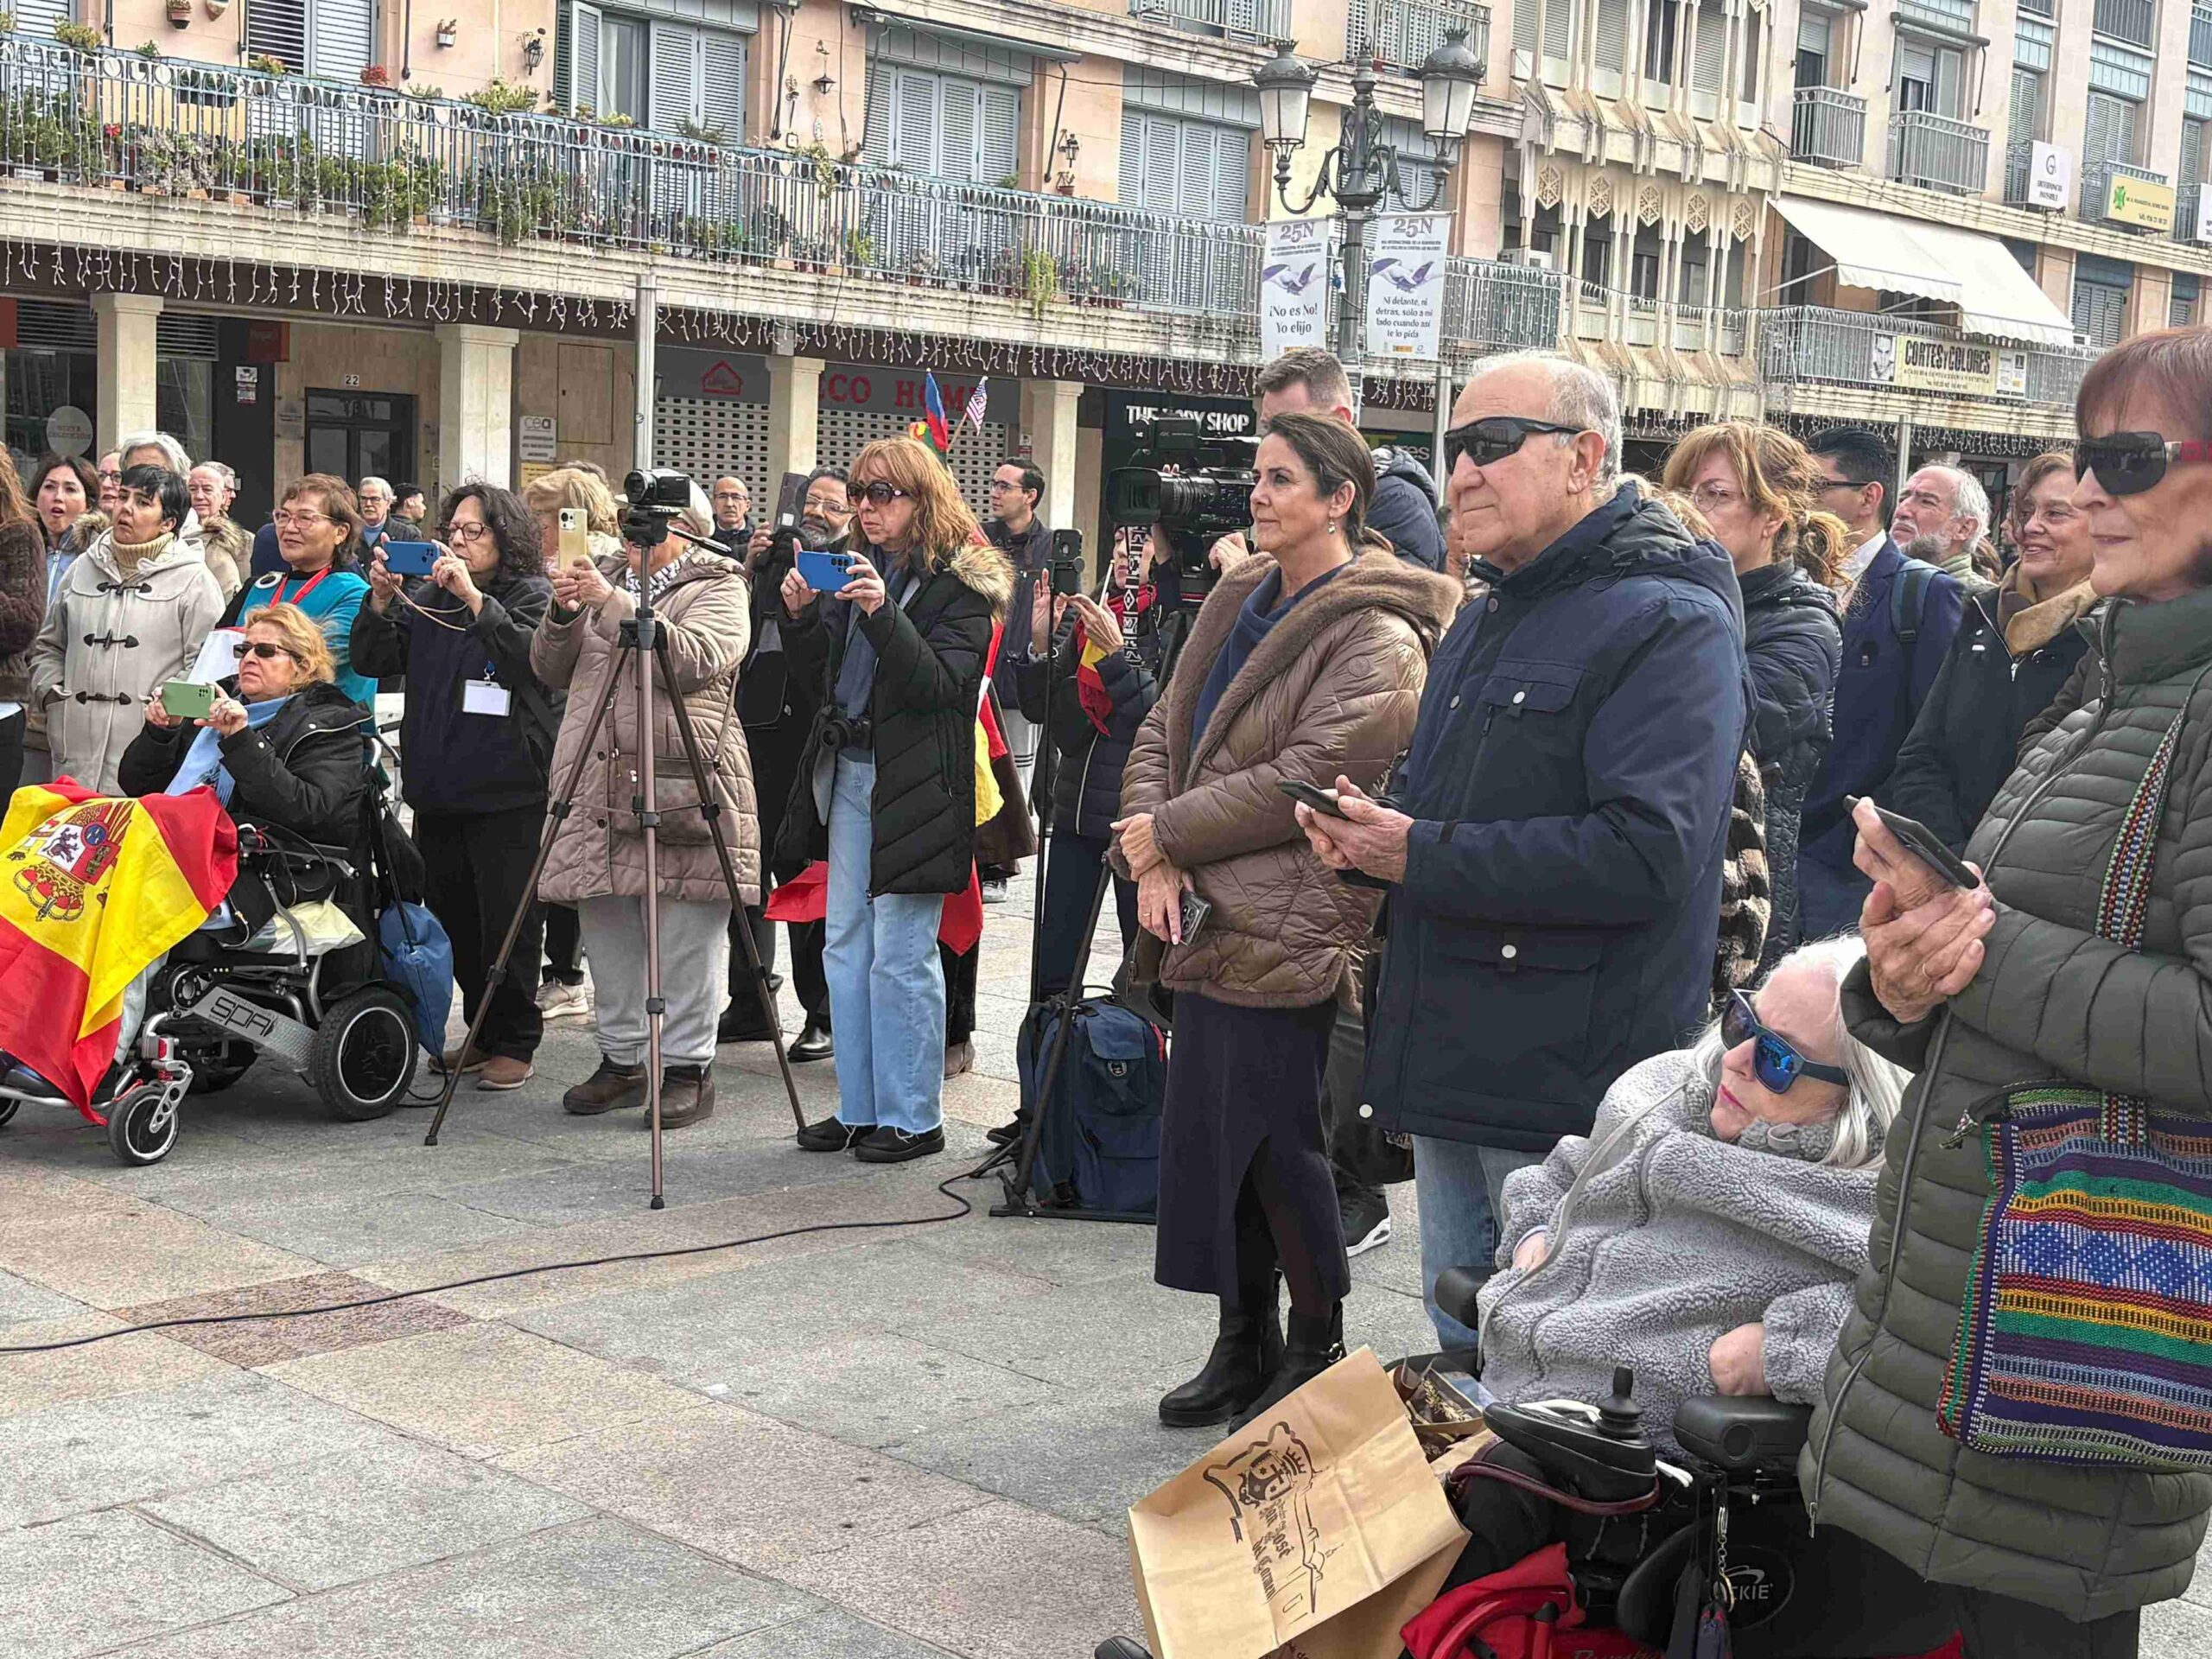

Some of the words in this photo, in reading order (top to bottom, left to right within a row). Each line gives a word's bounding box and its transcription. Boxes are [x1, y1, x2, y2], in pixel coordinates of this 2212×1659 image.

[1280, 222, 1313, 243] 25N
[1393, 218, 1433, 238] 25N
[1289, 307, 1300, 316] es
[1303, 302, 1318, 315] No!
[1276, 321, 1287, 334] Yo
[1290, 321, 1312, 335] elijo
[1393, 319, 1420, 327] cuando
[1403, 330, 1419, 339] pida
[346, 375, 359, 385] 22
[524, 416, 551, 429] cea
[1206, 412, 1249, 432] SHOP
